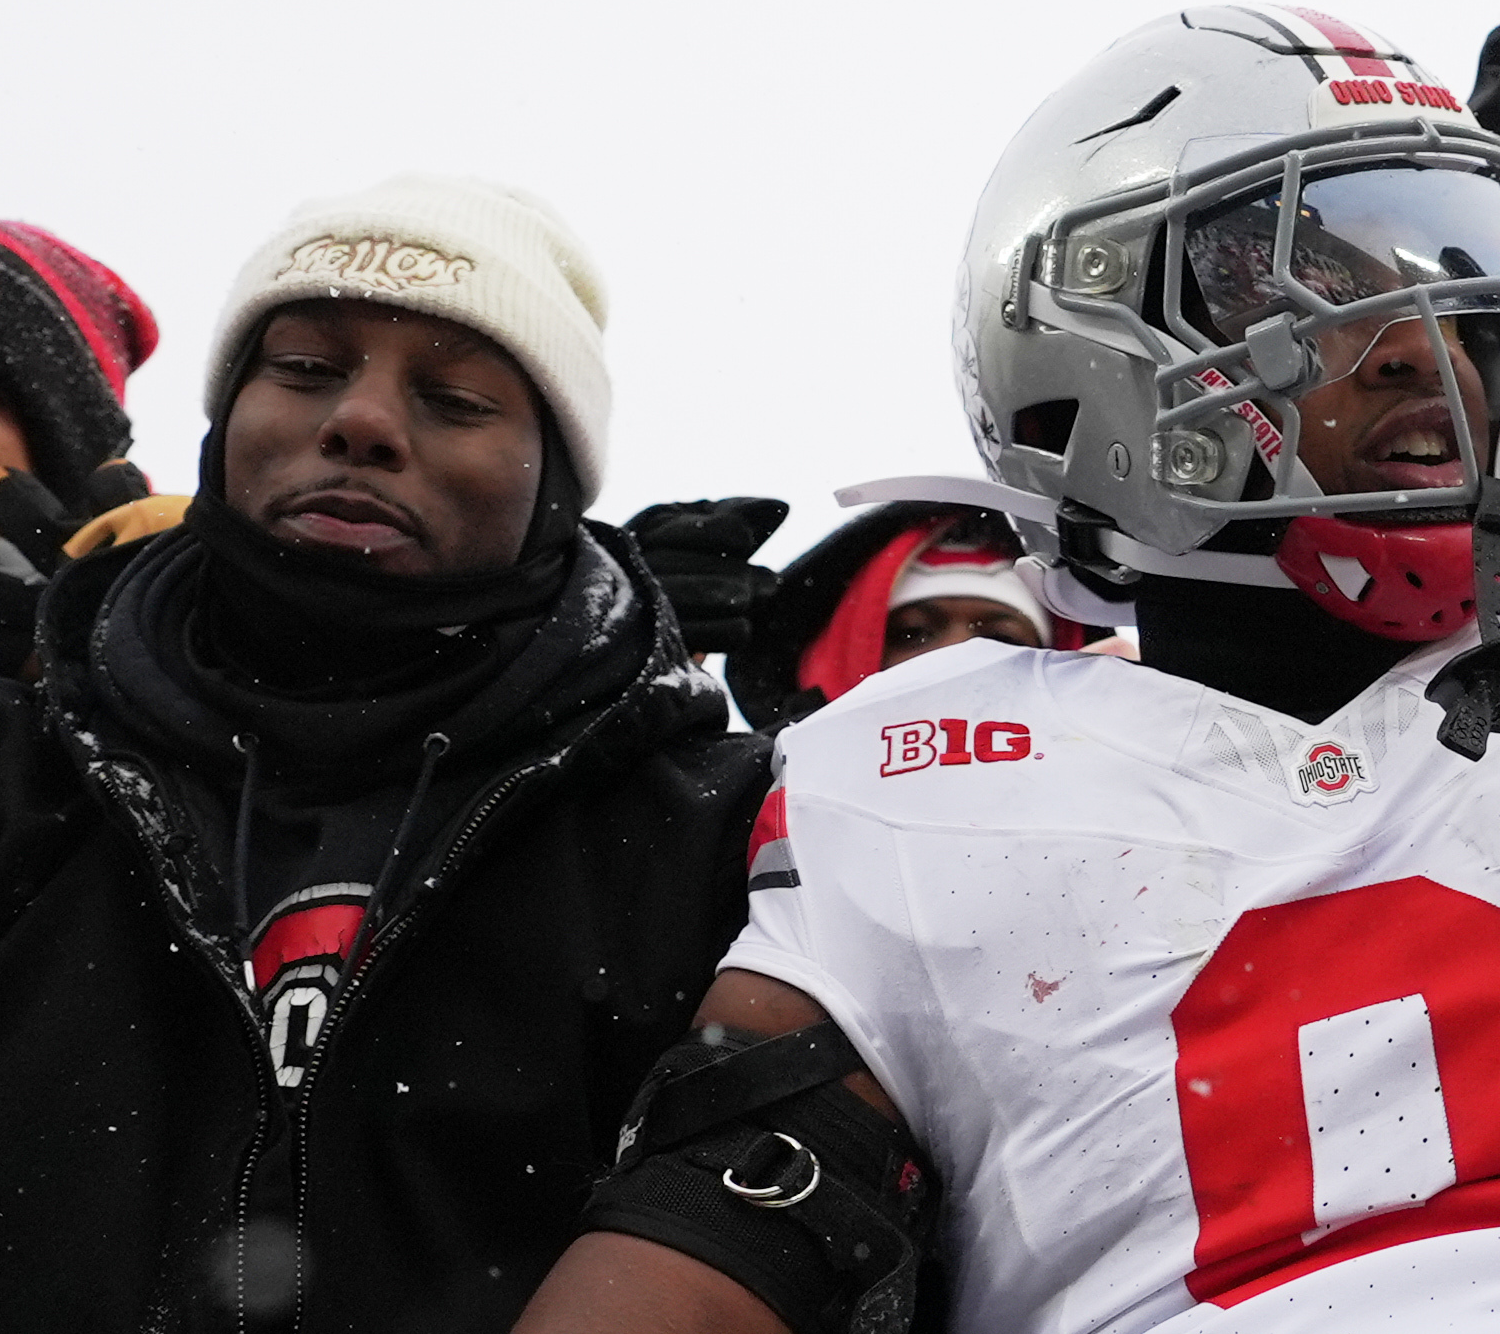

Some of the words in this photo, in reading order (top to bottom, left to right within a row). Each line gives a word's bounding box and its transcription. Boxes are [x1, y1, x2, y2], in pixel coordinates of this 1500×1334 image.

[1329, 79, 1393, 105] OHIO
[1394, 80, 1463, 113] STATE
[1238, 402, 1283, 463] STATE
